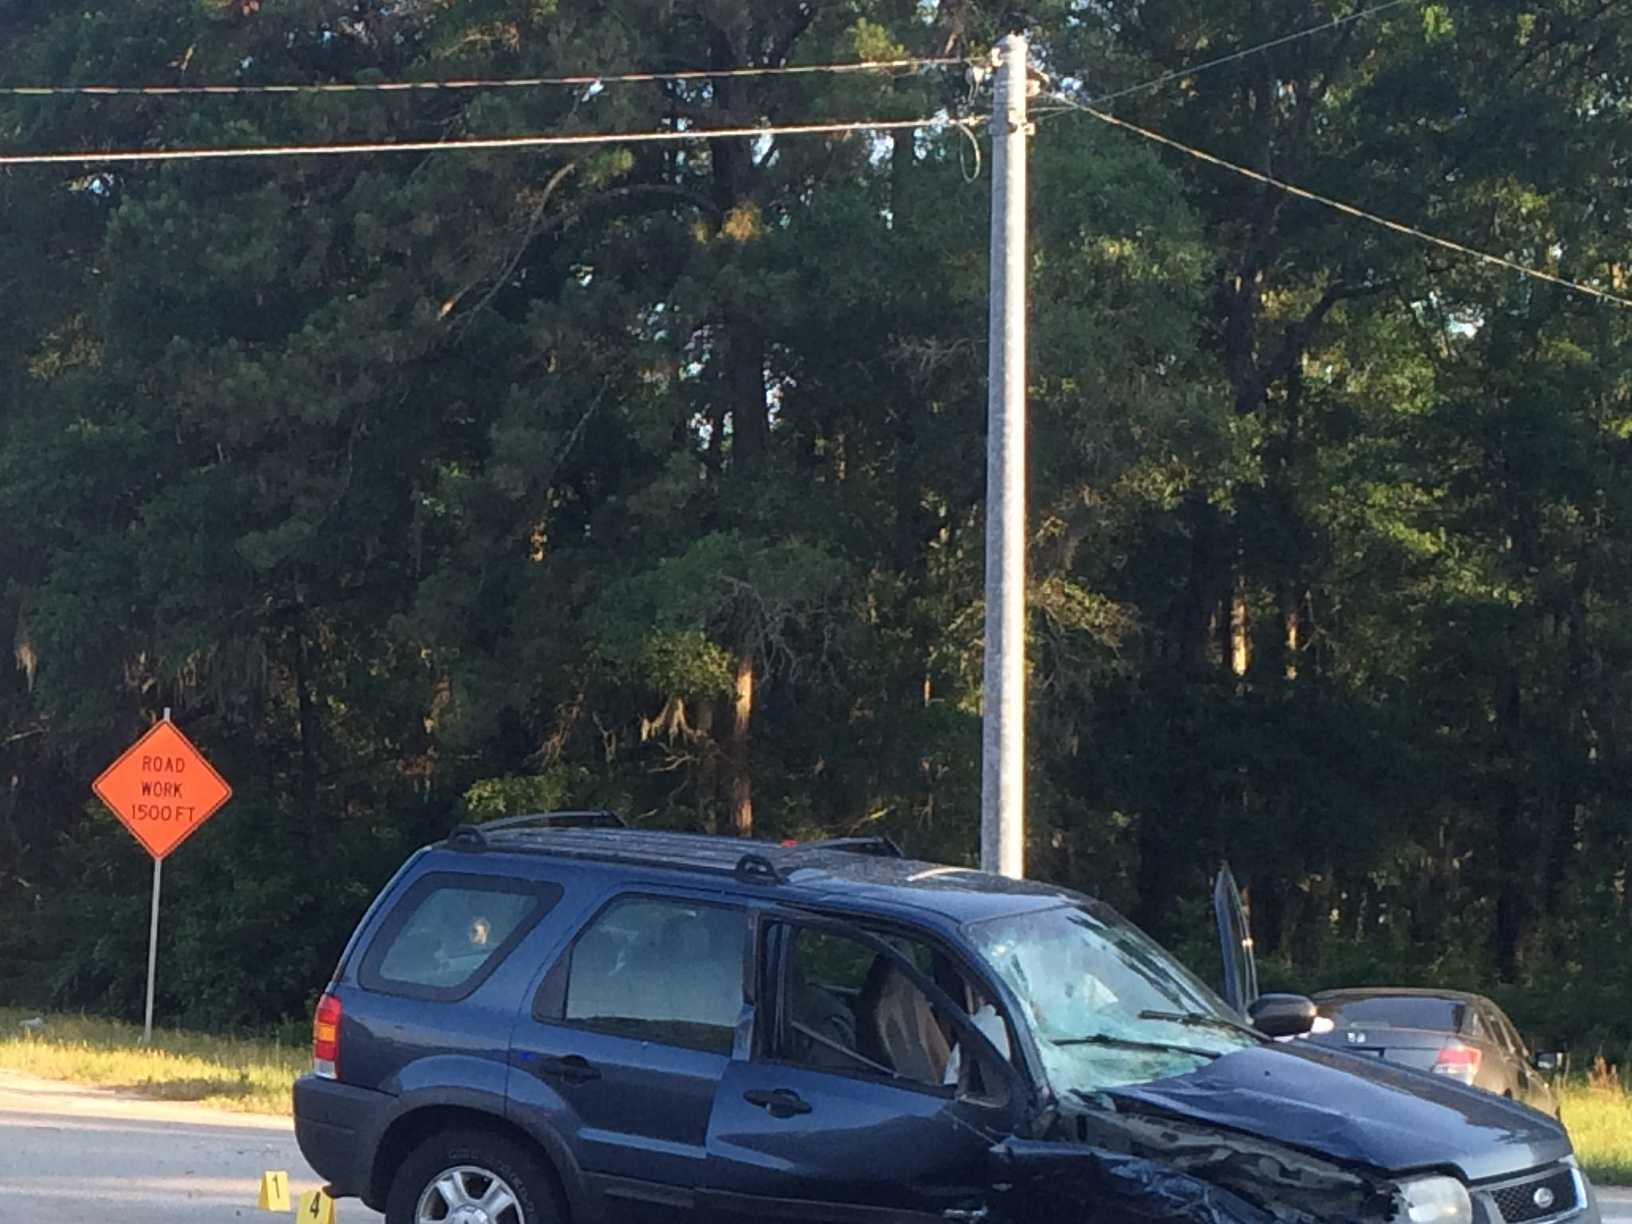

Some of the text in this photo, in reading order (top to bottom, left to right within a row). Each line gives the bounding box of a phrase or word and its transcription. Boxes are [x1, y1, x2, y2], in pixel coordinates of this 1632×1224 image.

[142, 755, 186, 774] ROAD
[141, 781, 183, 798] WORK
[271, 1173, 281, 1200] 1
[309, 1191, 321, 1218] 4
